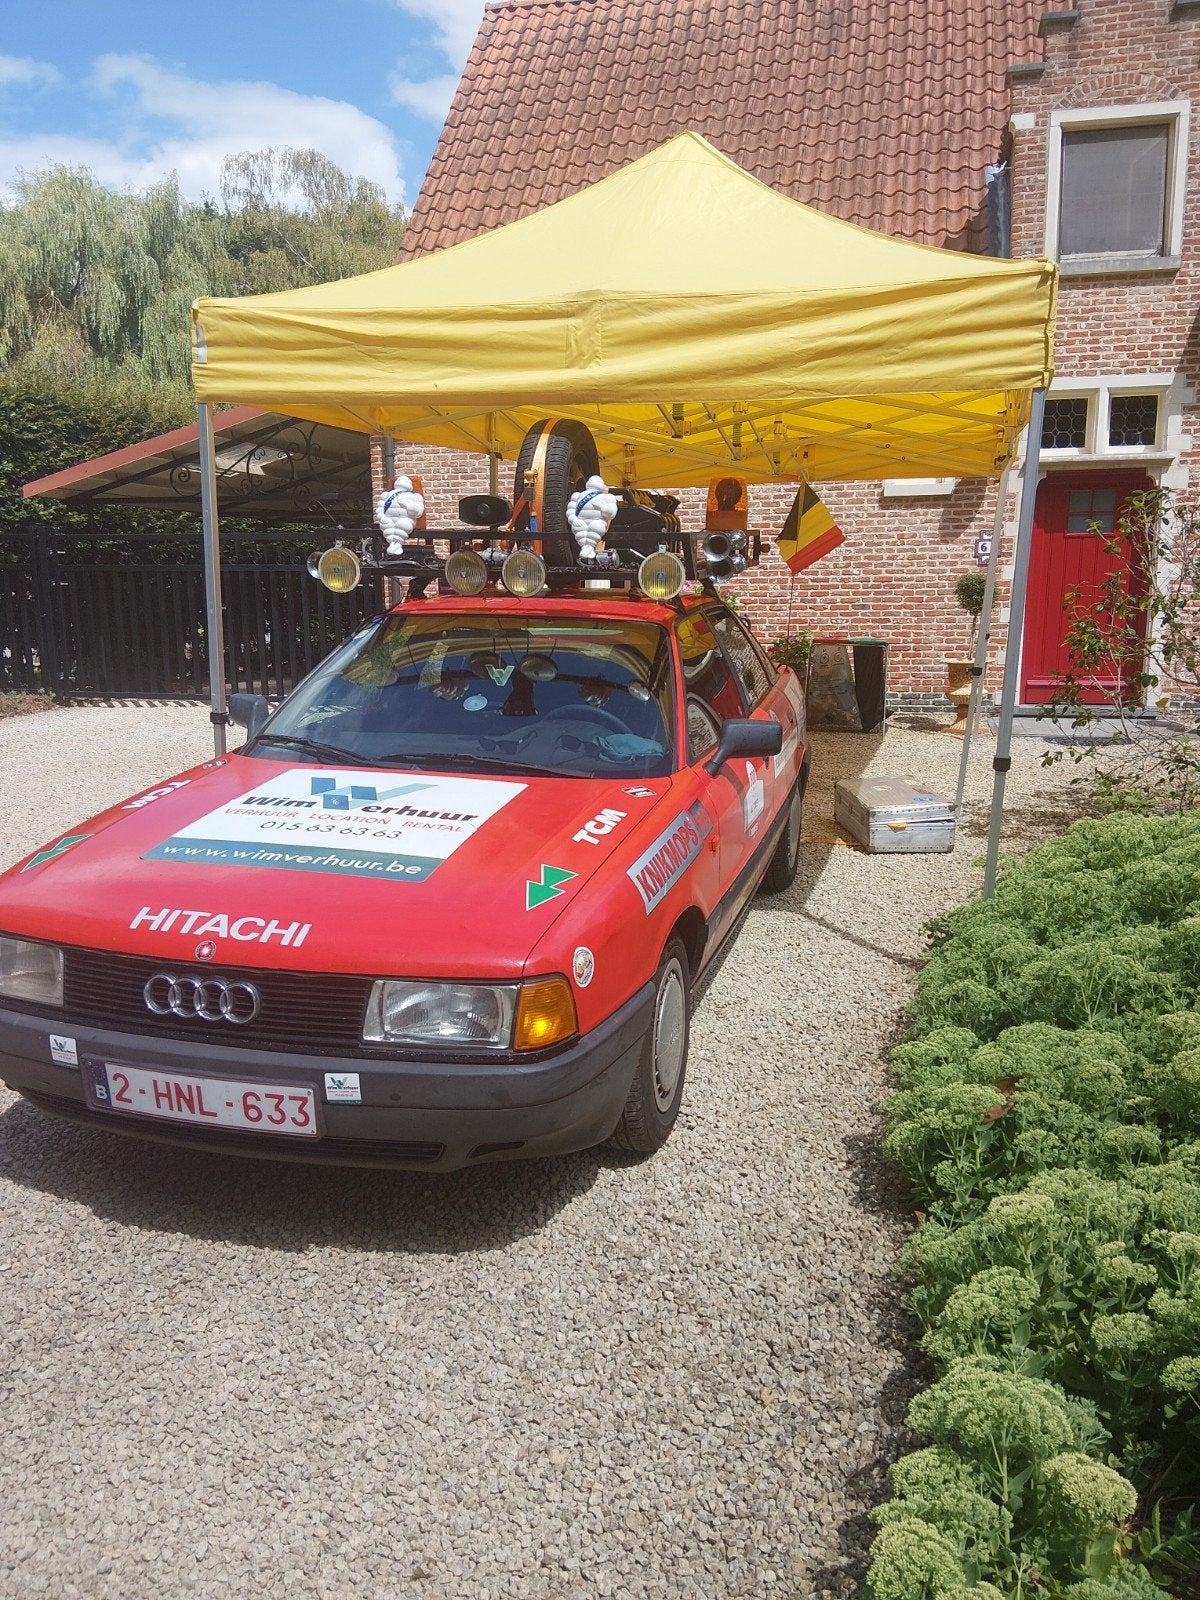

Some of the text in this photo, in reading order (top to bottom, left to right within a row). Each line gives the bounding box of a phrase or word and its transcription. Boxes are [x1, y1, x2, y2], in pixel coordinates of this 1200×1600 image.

[980, 542, 988, 552] 6
[241, 796, 318, 808] Wim
[225, 808, 463, 833] VERHUUR LOCATION RENTAL
[260, 820, 402, 839] 015 63 63 63
[571, 808, 628, 845] TCM
[163, 846, 422, 875] www.wimverhuur.be
[636, 820, 699, 903] KNIKMOPS
[129, 906, 312, 947] HITACHI
[95, 1084, 108, 1100] B
